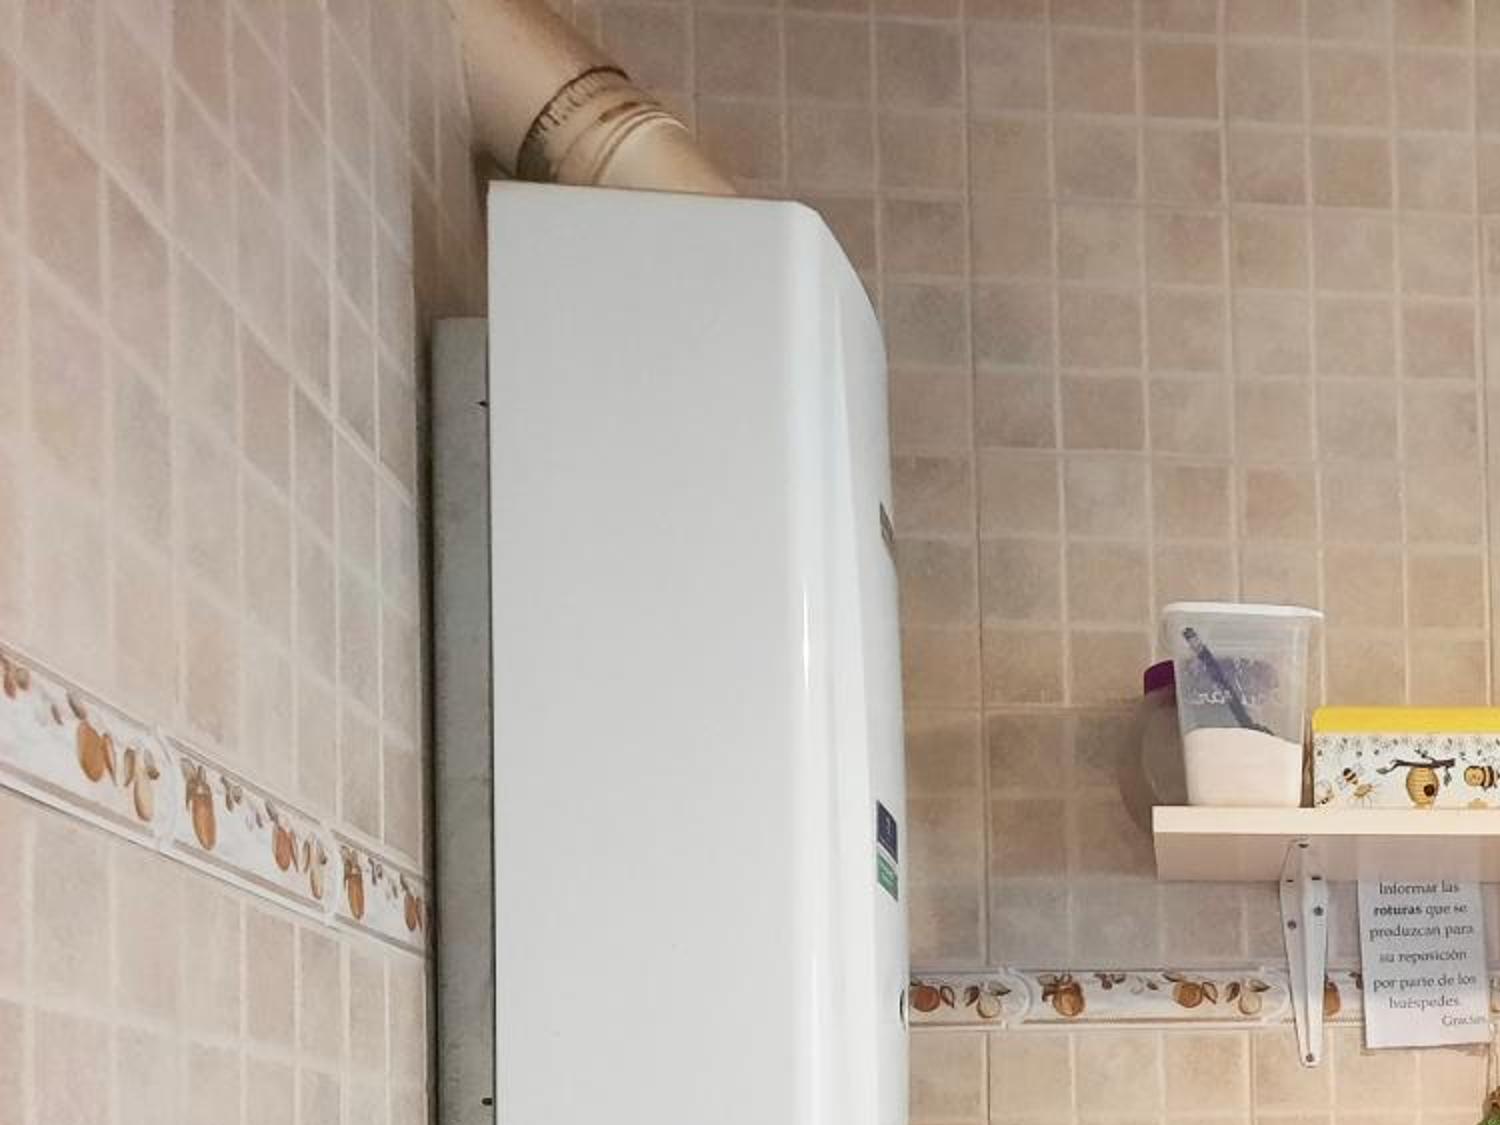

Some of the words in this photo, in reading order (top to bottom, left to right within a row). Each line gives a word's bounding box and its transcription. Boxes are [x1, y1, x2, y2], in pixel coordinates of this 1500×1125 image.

[1379, 881, 1437, 895] Informar
[1441, 879, 1460, 893] las
[1374, 904, 1422, 916] roturas
[1425, 904, 1451, 918] que
[1453, 904, 1467, 913] se
[1369, 924, 1441, 941] produzcan
[1444, 924, 1473, 939] para
[1379, 952, 1395, 963] su
[1398, 949, 1467, 964] reposición
[1373, 979, 1398, 992] por
[1399, 977, 1435, 991] parte
[1437, 973, 1455, 987] de
[1457, 972, 1477, 985] los
